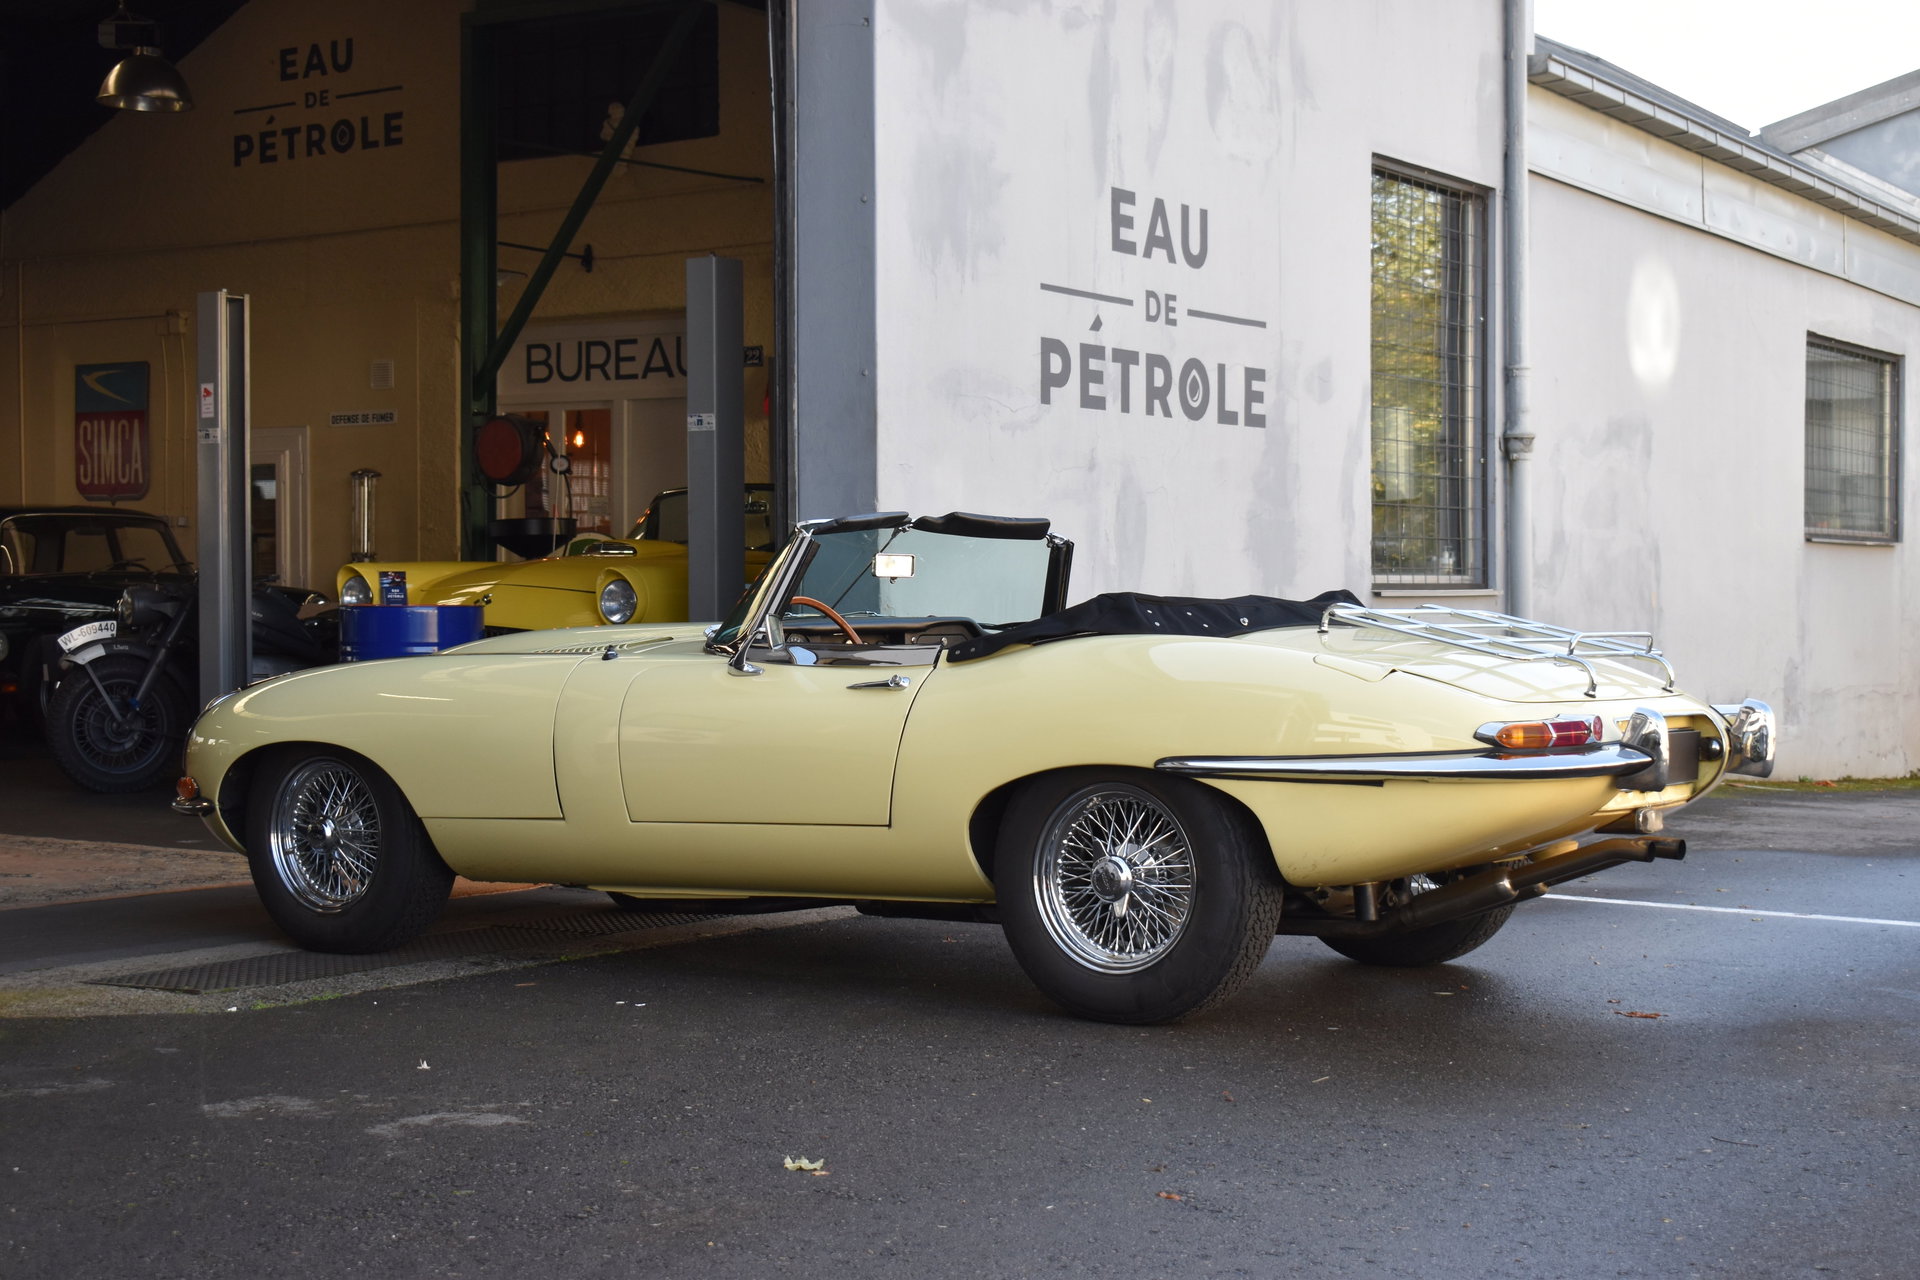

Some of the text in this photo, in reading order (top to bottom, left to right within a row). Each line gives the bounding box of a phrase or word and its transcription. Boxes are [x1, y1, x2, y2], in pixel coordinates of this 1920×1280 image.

[280, 38, 353, 81] EAU
[305, 90, 329, 108] DE
[234, 112, 403, 167] PÉTROLE
[1111, 187, 1208, 269] EAU
[1145, 289, 1178, 328] DE
[1040, 313, 1266, 428] PÉTROLE
[361, 414, 369, 423] DE
[79, 418, 144, 485] SIMCA
